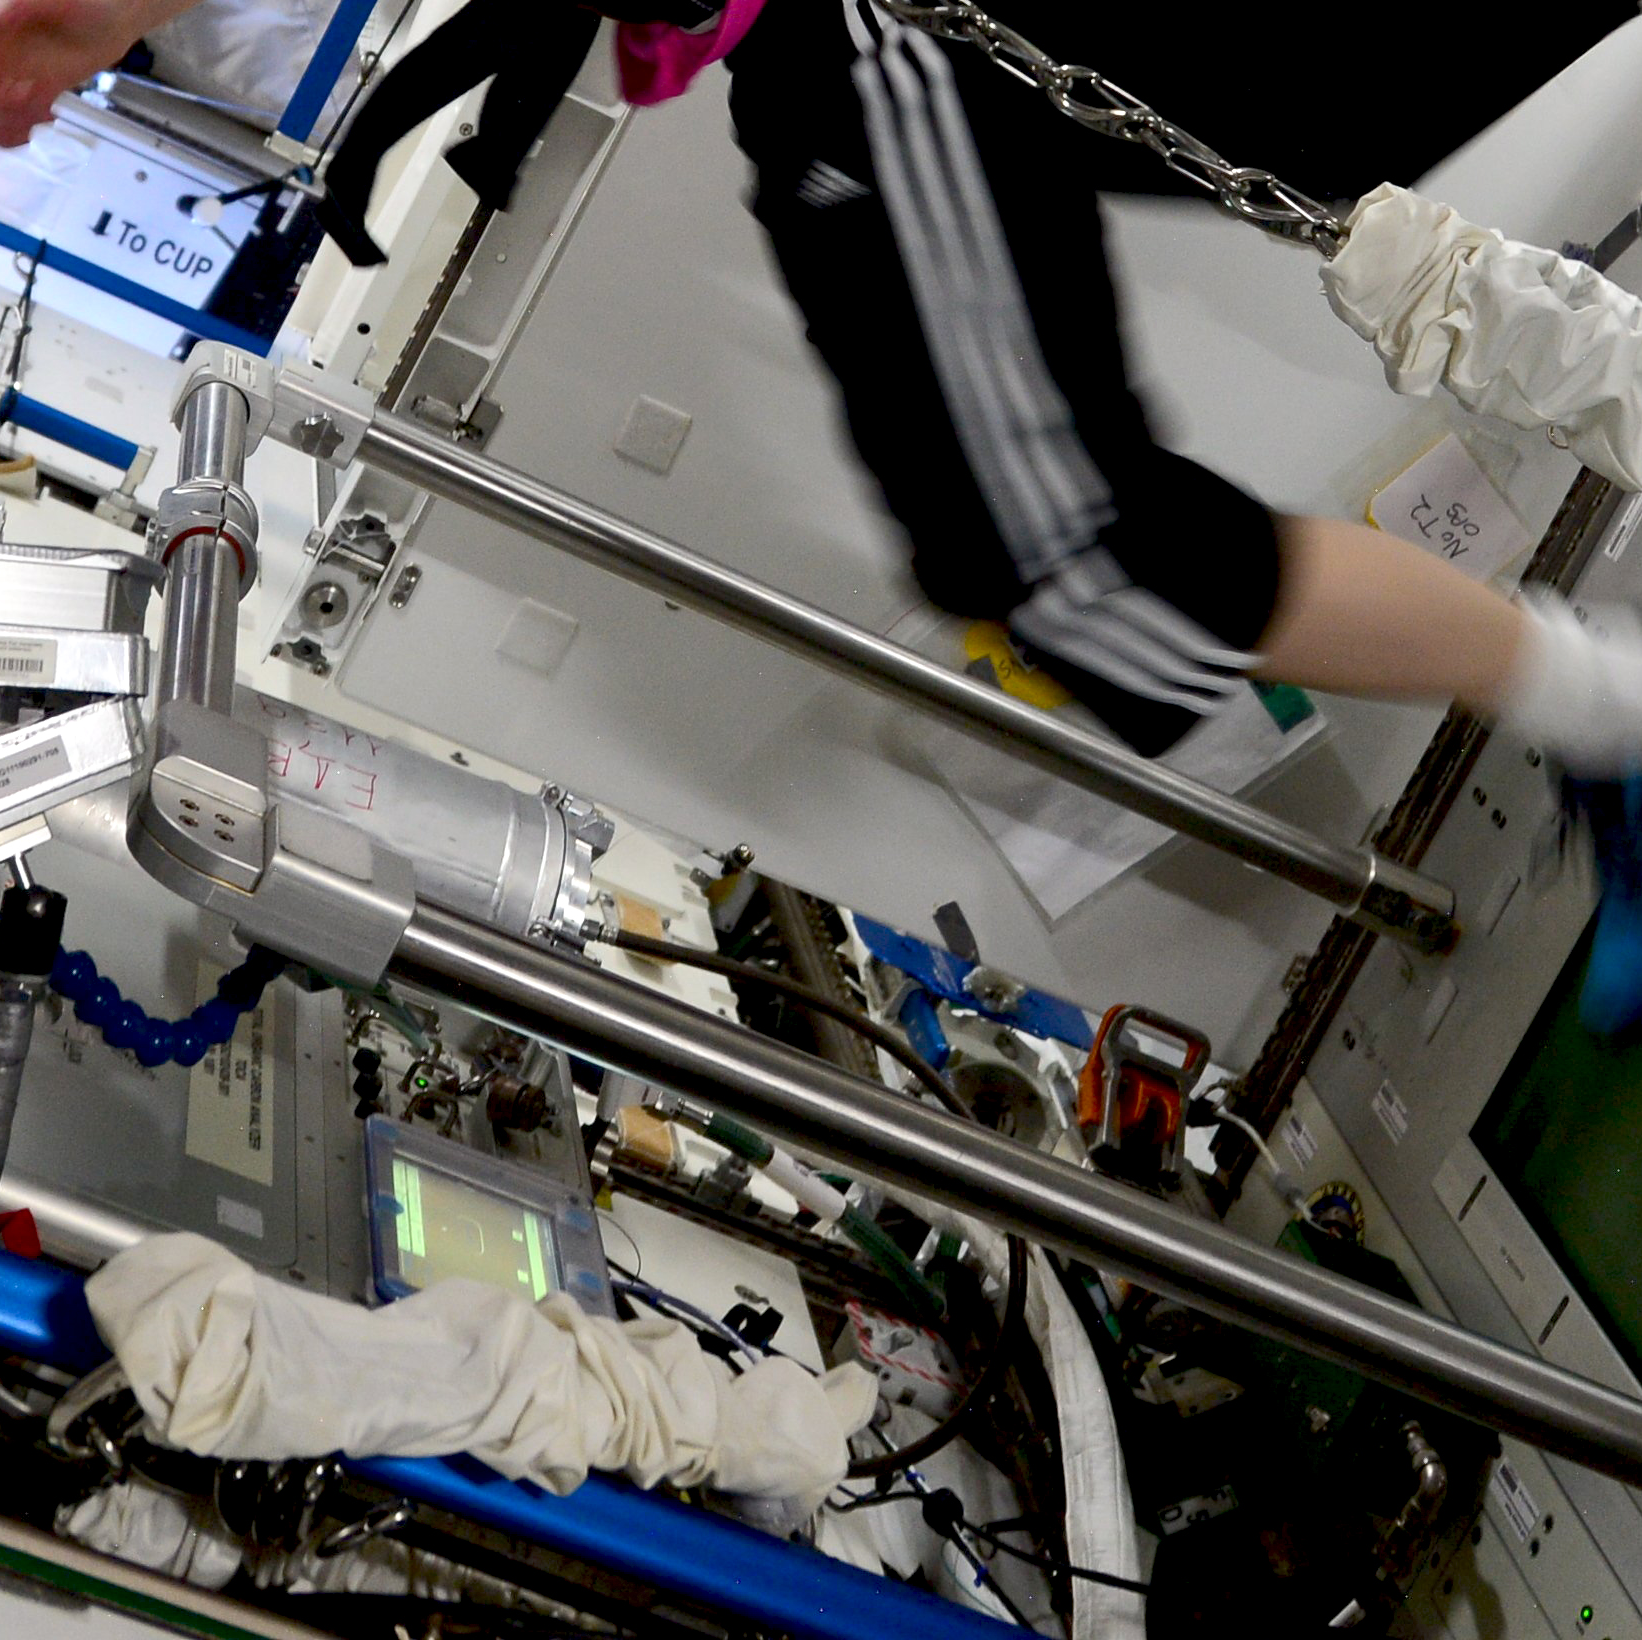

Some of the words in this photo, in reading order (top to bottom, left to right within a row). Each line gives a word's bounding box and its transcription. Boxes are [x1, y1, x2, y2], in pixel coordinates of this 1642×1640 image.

[119, 219, 147, 254] To
[153, 238, 215, 279] CUP
[1441, 531, 1470, 559] No
